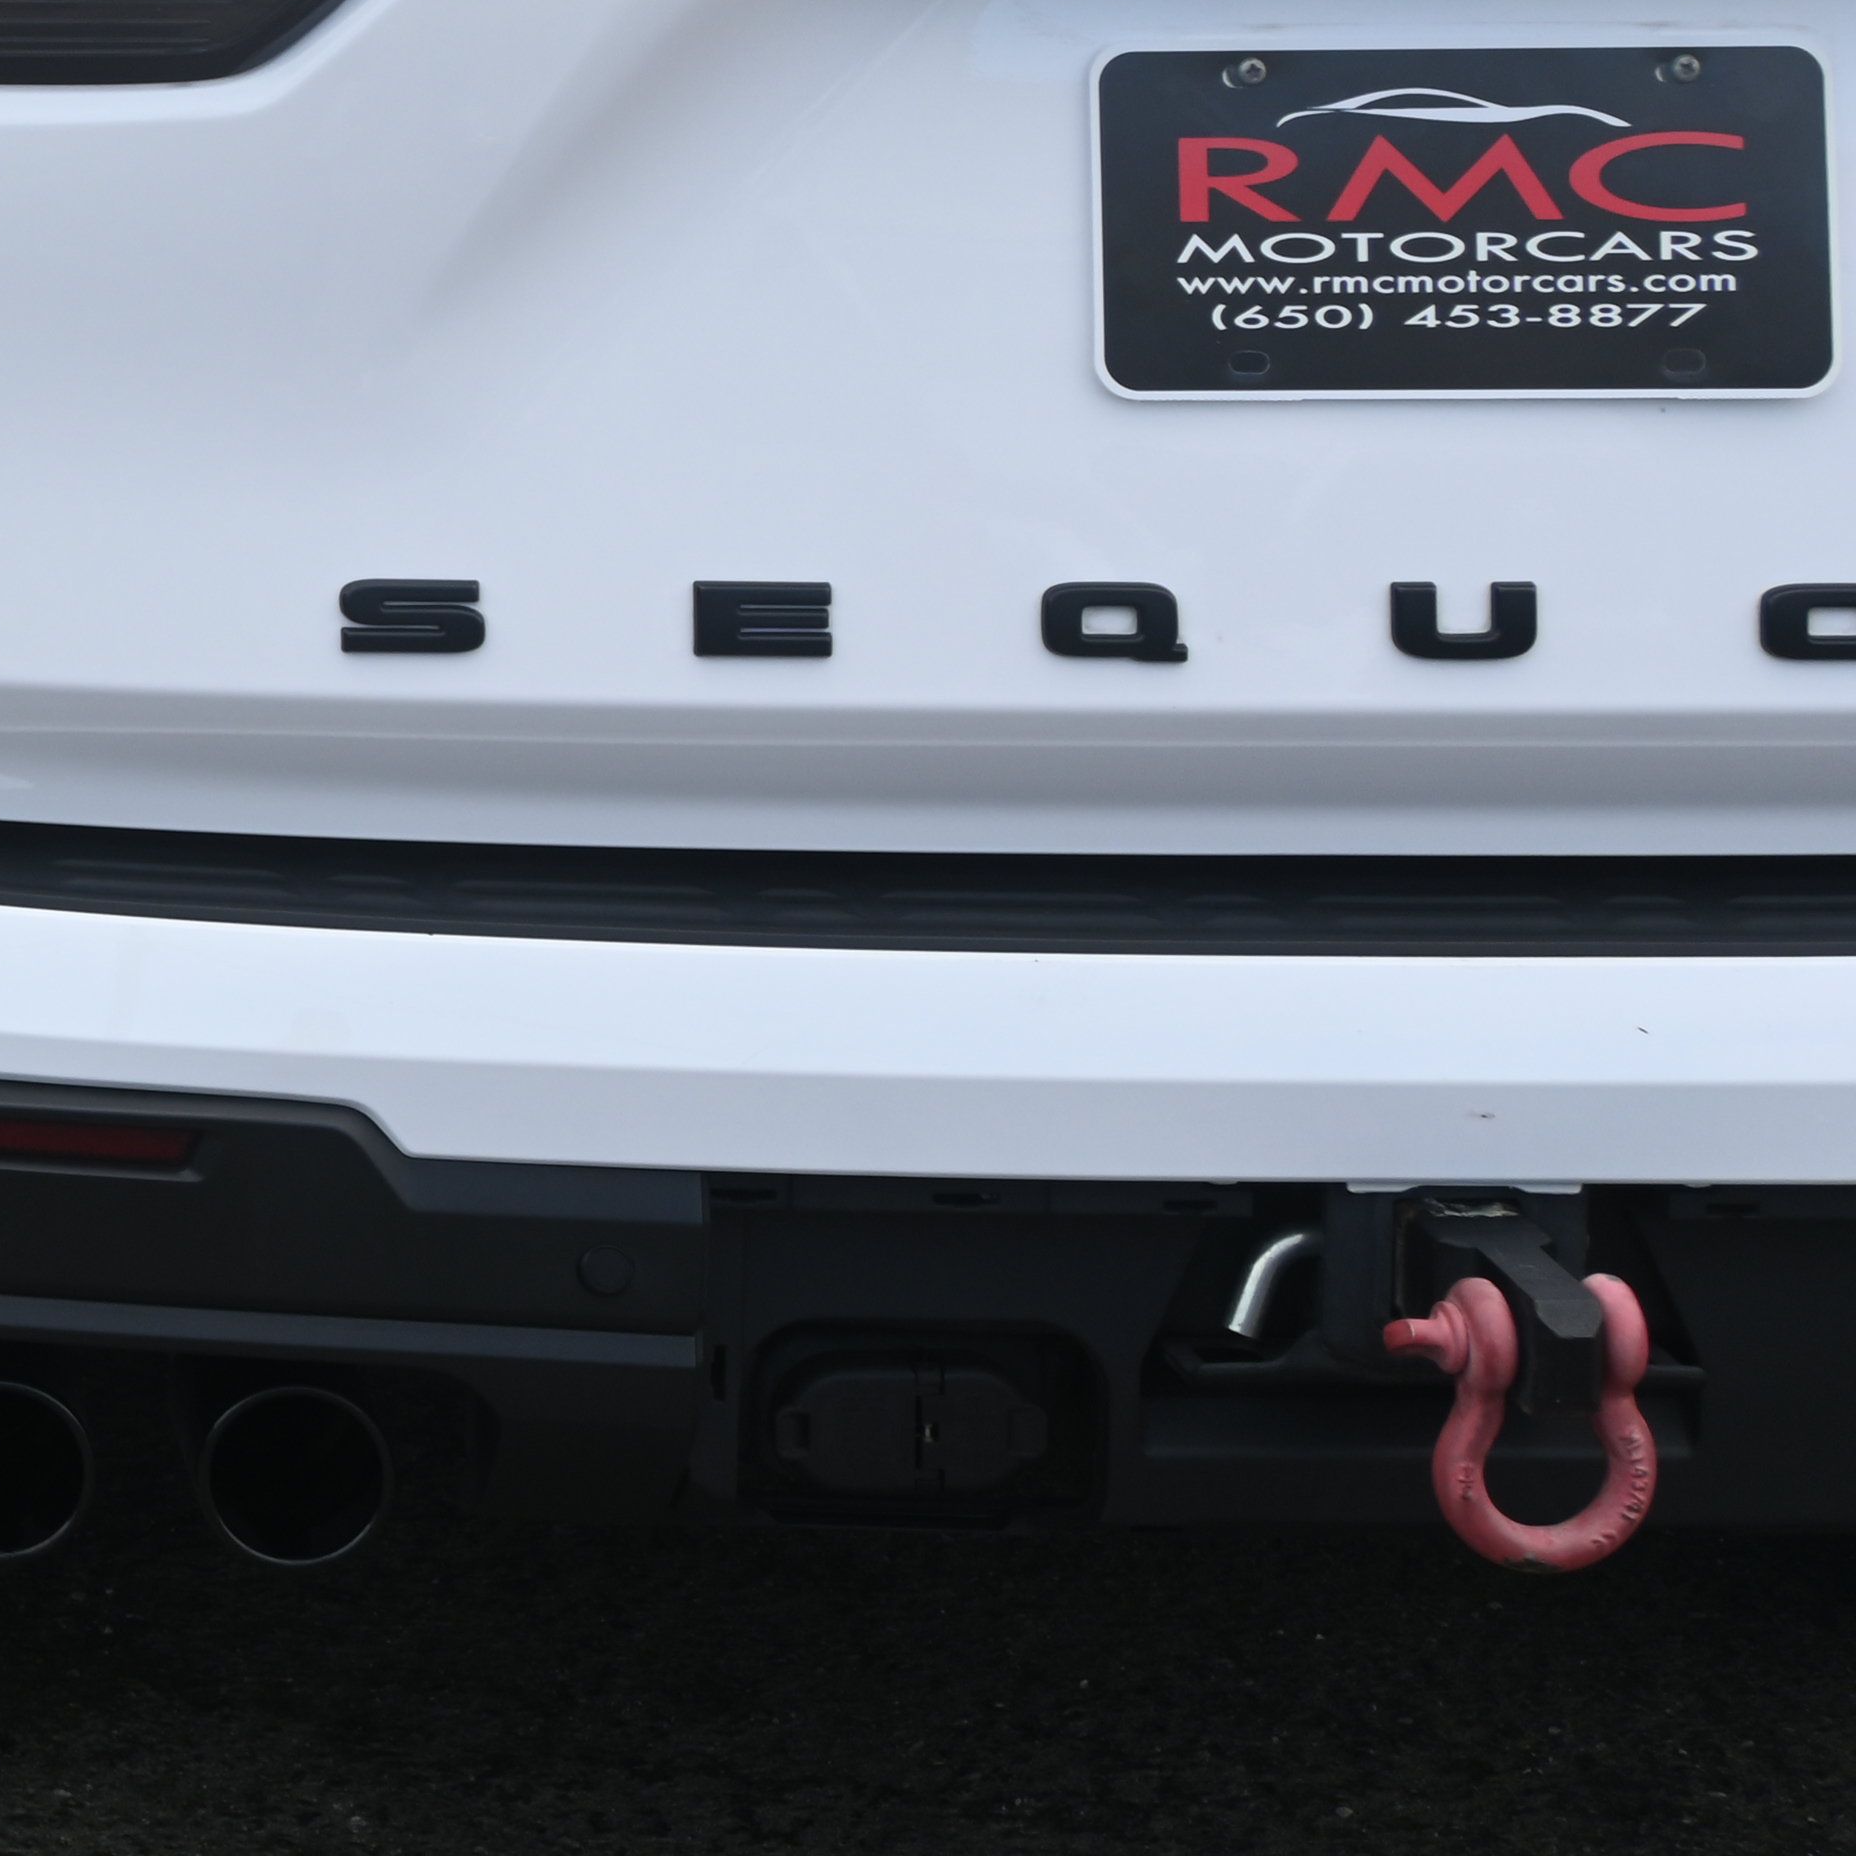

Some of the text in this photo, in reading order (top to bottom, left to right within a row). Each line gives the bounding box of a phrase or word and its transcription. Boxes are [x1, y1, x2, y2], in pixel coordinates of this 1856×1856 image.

[1177, 130, 1748, 223] RMC
[1177, 230, 1759, 263] MOTORCARS
[1177, 270, 1737, 295] www.rmcmotorcars.com
[1212, 303, 1707, 330] (650) 453-8877
